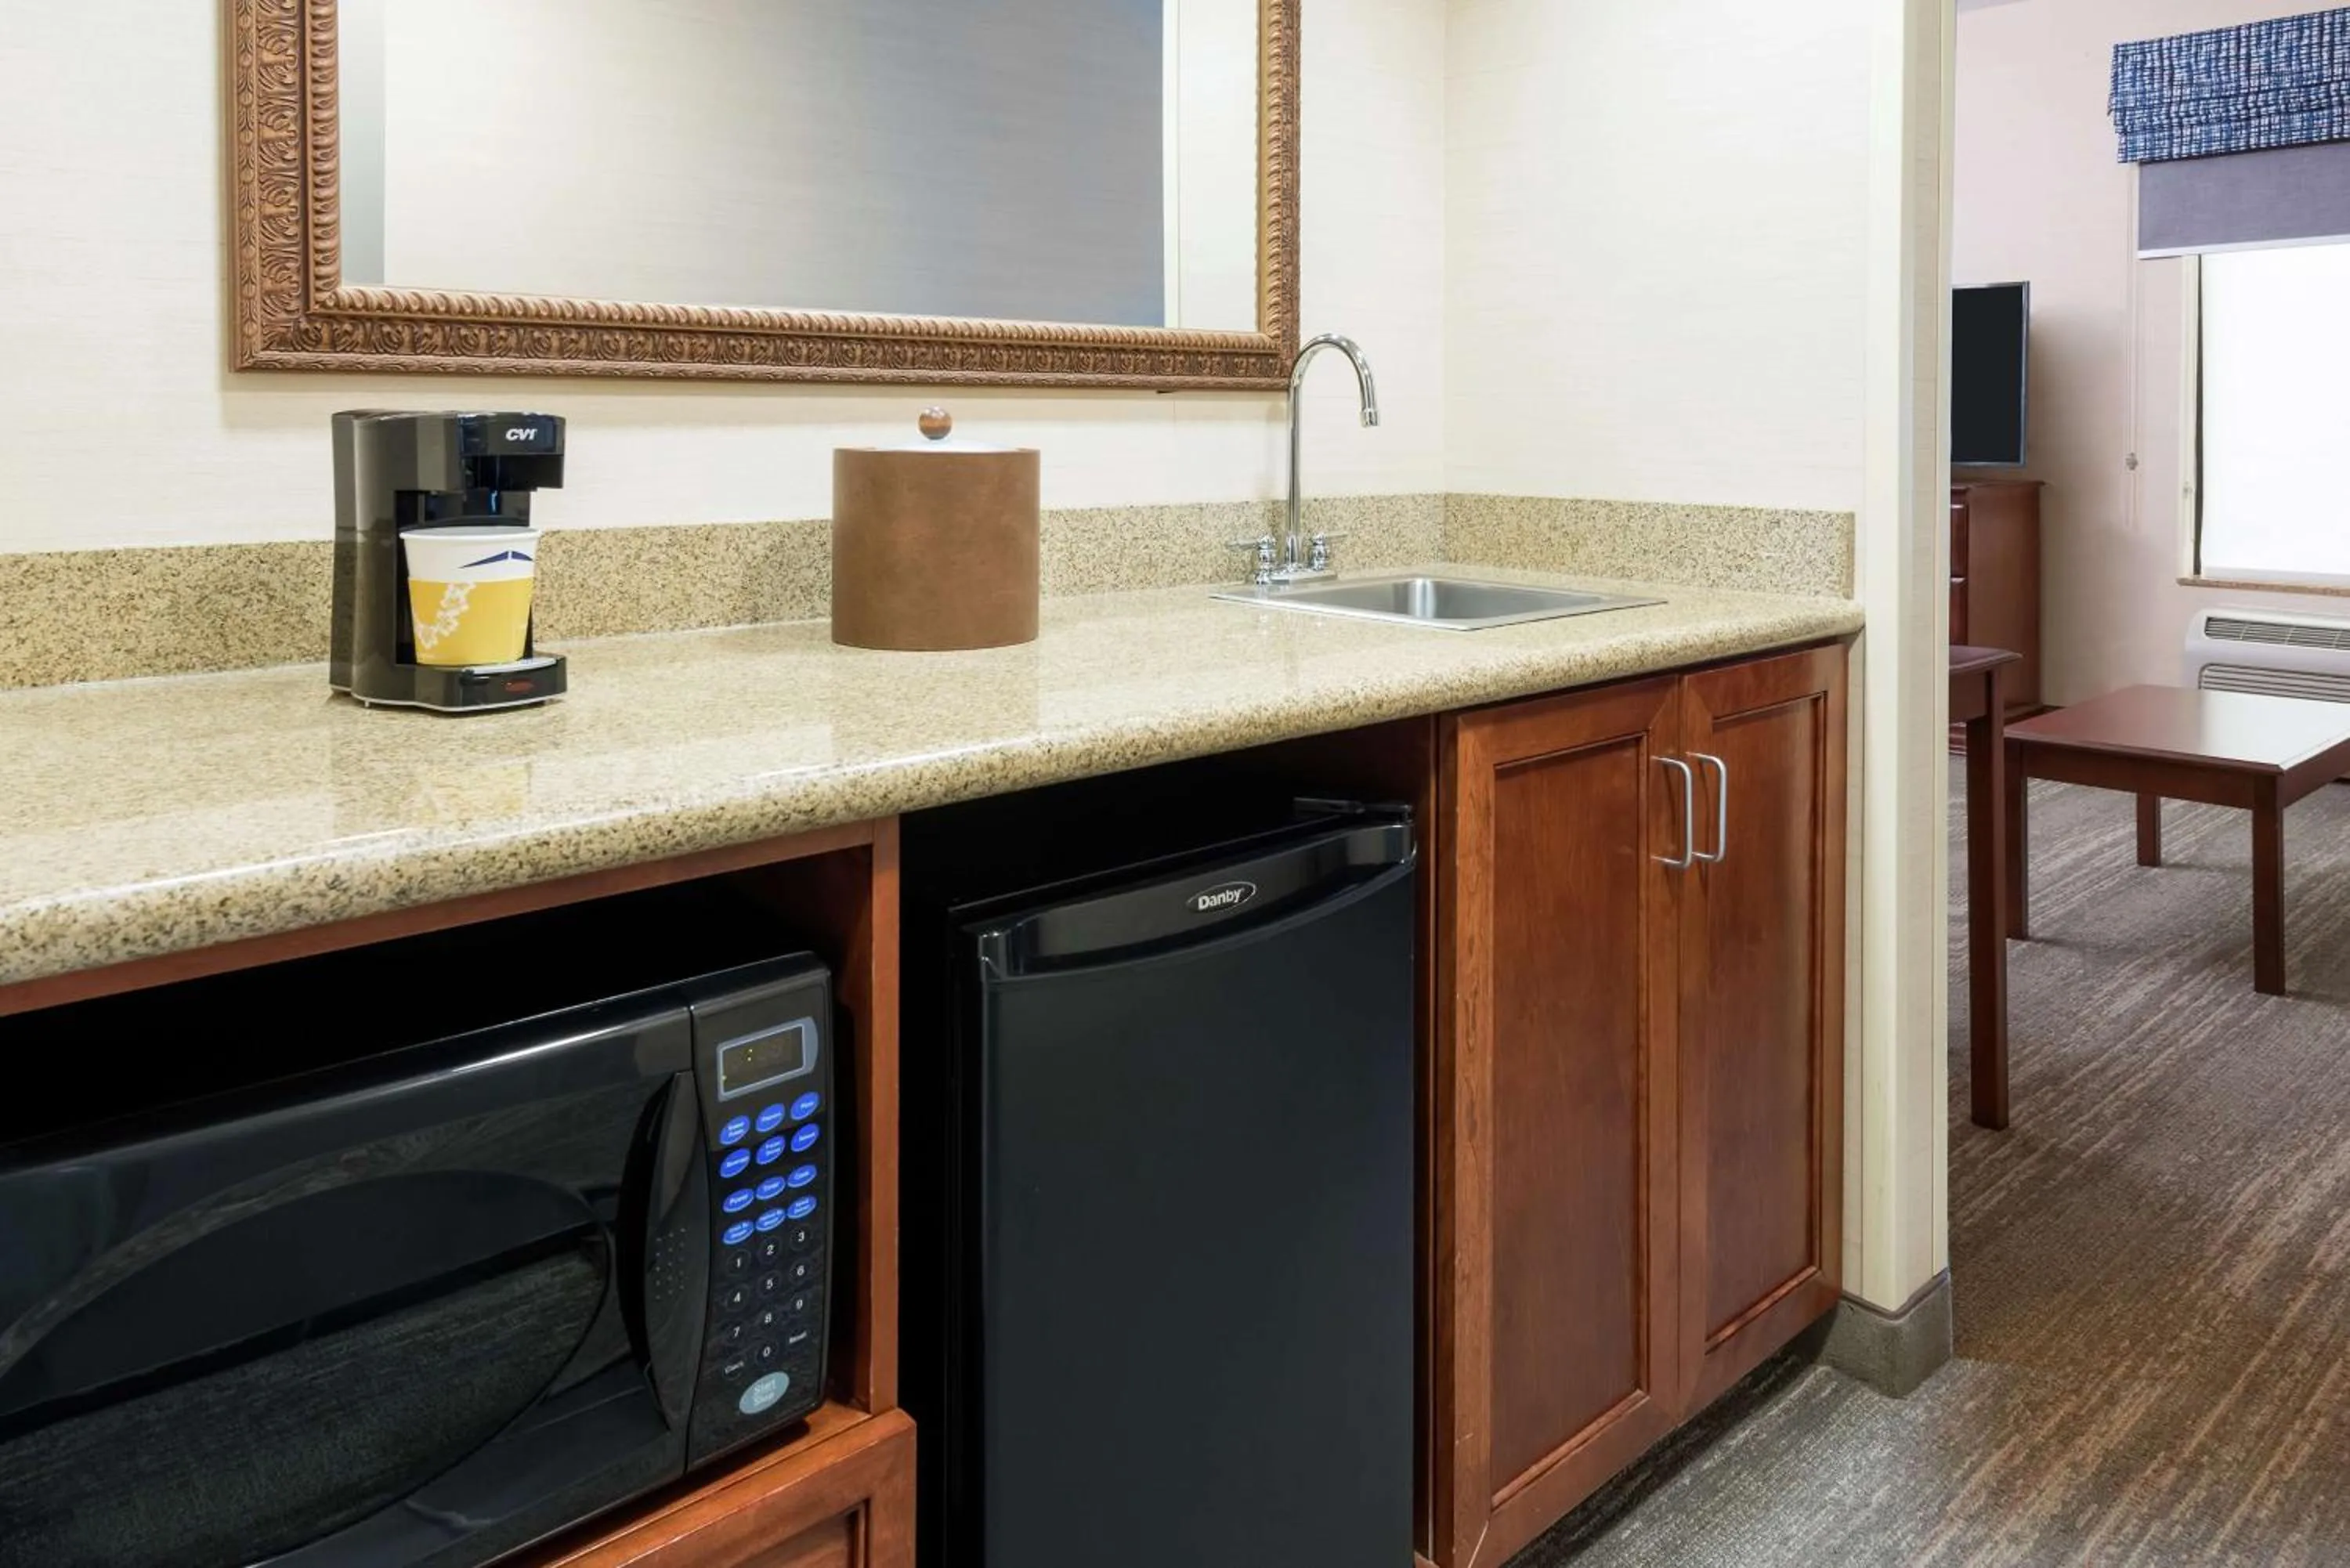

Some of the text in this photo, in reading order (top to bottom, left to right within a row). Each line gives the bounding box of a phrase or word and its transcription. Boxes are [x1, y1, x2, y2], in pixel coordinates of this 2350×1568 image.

[1198, 887, 1245, 910] Danby
[798, 1230, 804, 1242] 3
[766, 1244, 774, 1255] 2
[797, 1265, 804, 1276] 6
[733, 1292, 740, 1302] 4
[733, 1326, 739, 1337] 7
[763, 1346, 771, 1357] 0
